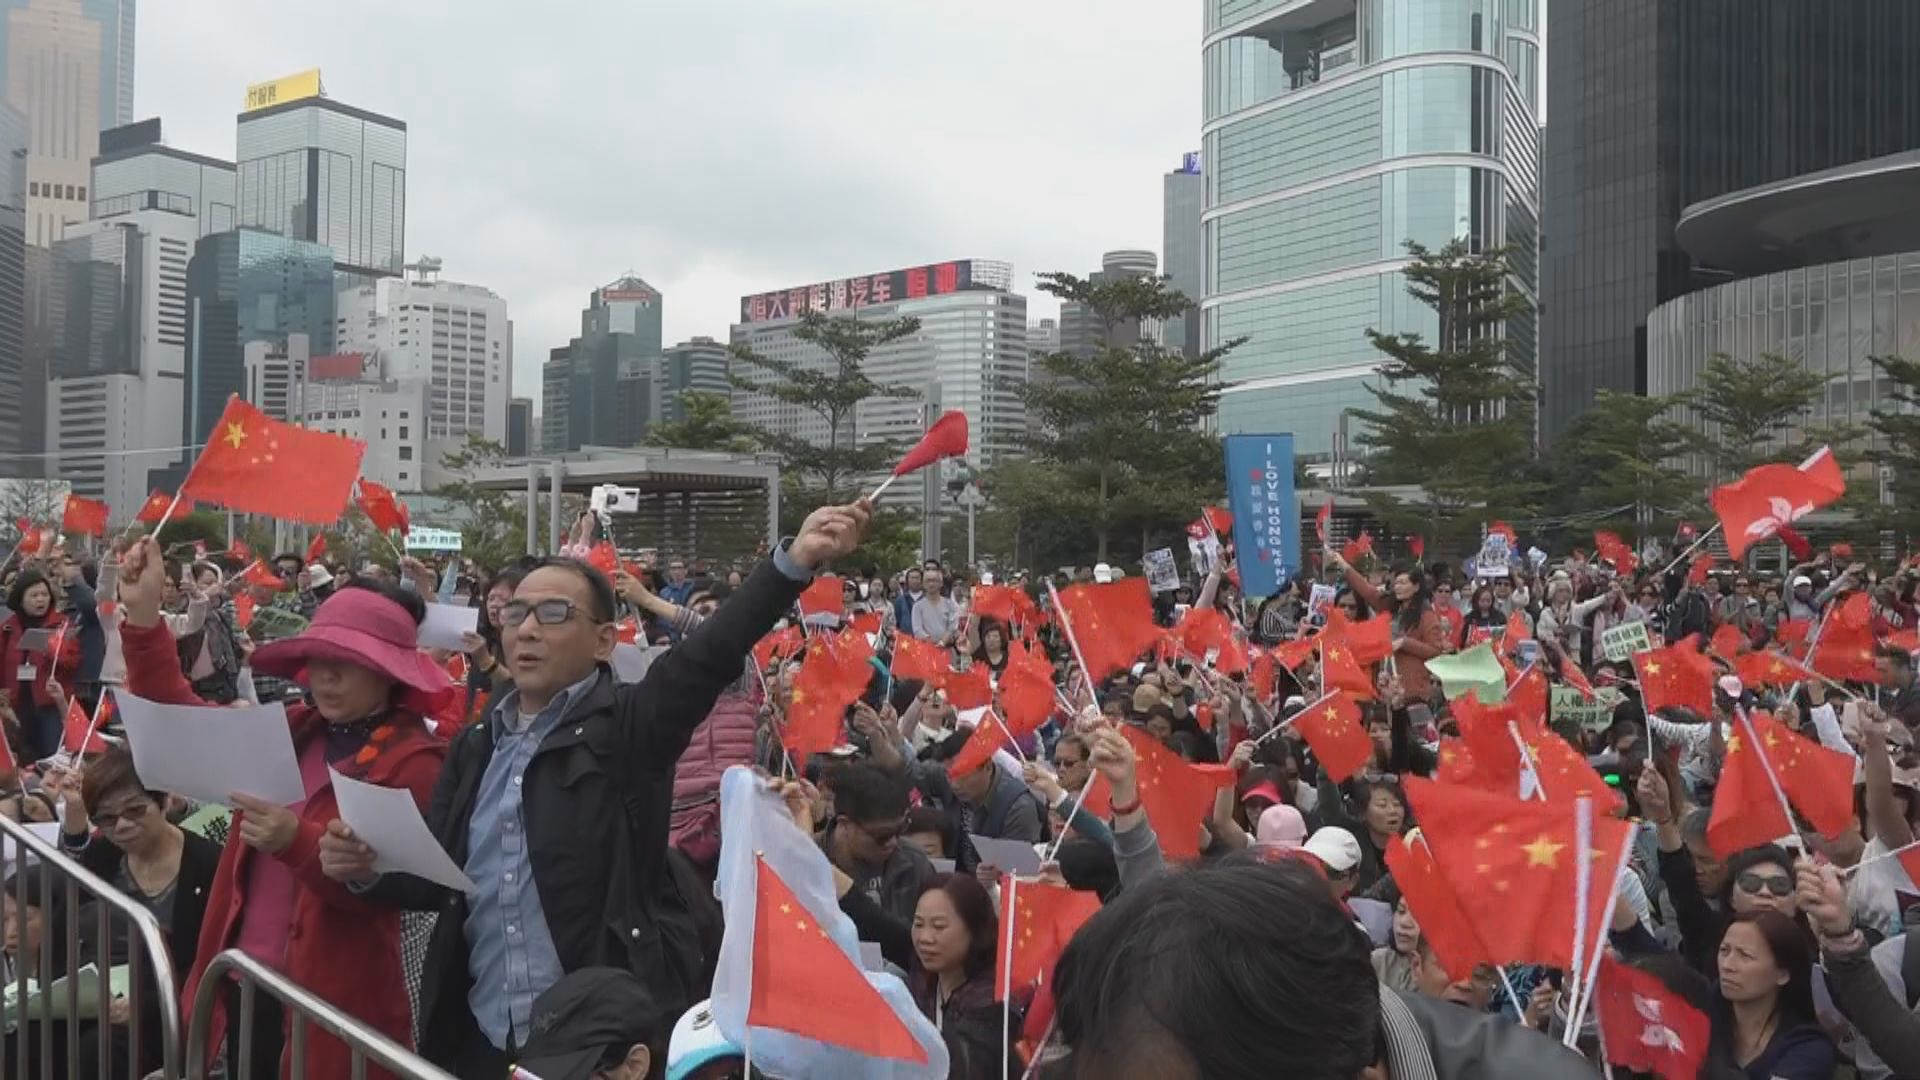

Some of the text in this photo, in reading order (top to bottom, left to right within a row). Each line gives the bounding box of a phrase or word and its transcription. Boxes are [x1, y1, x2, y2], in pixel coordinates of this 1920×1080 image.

[1266, 442, 1272, 455] I
[1265, 460, 1279, 501] LOVE
[1267, 506, 1281, 546] HONG
